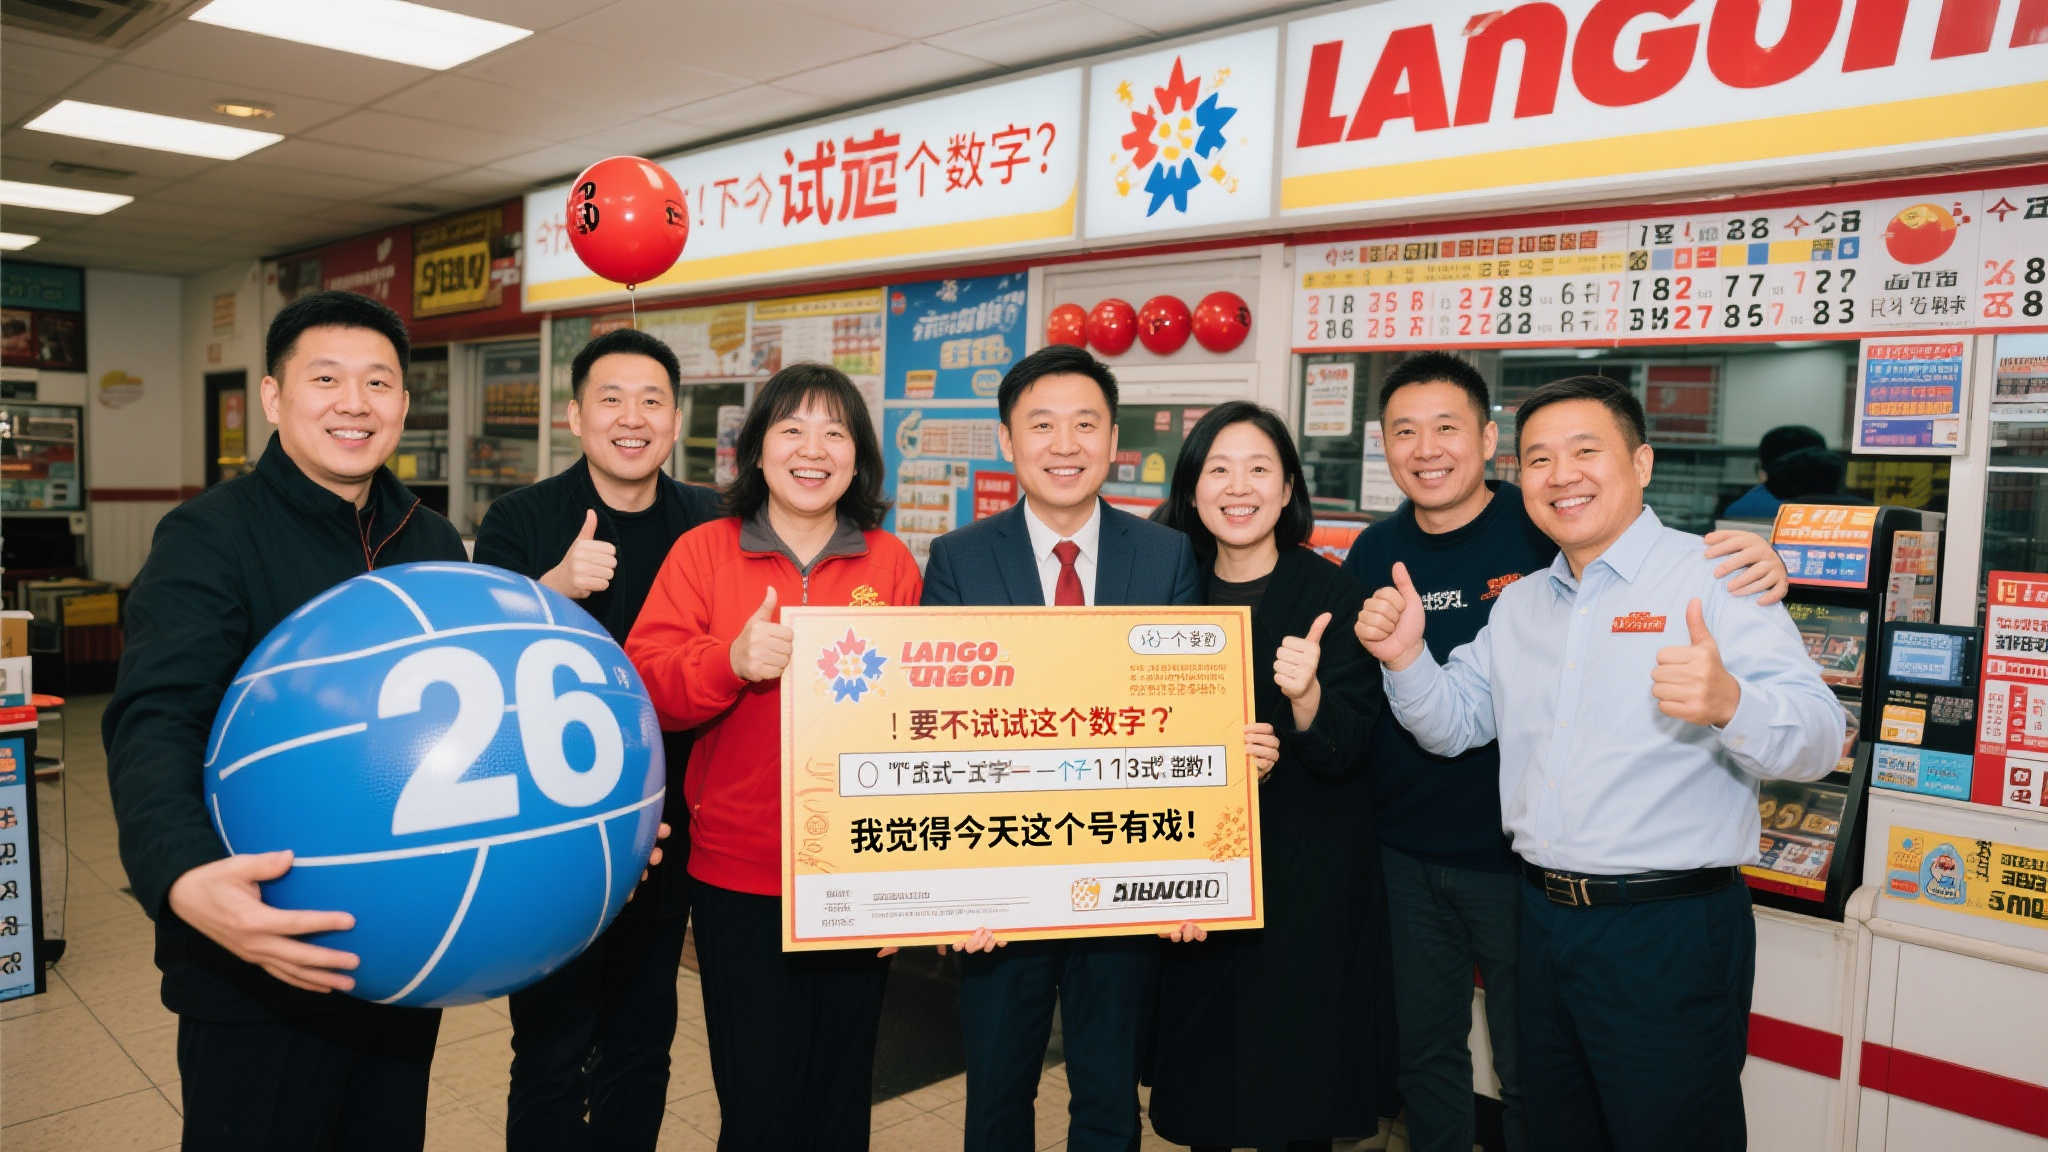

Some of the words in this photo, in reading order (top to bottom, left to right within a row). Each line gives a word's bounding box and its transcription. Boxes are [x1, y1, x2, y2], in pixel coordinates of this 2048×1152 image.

[378, 638, 625, 836] 26
[850, 809, 1196, 854] 我觉得今天这个号有戏!
